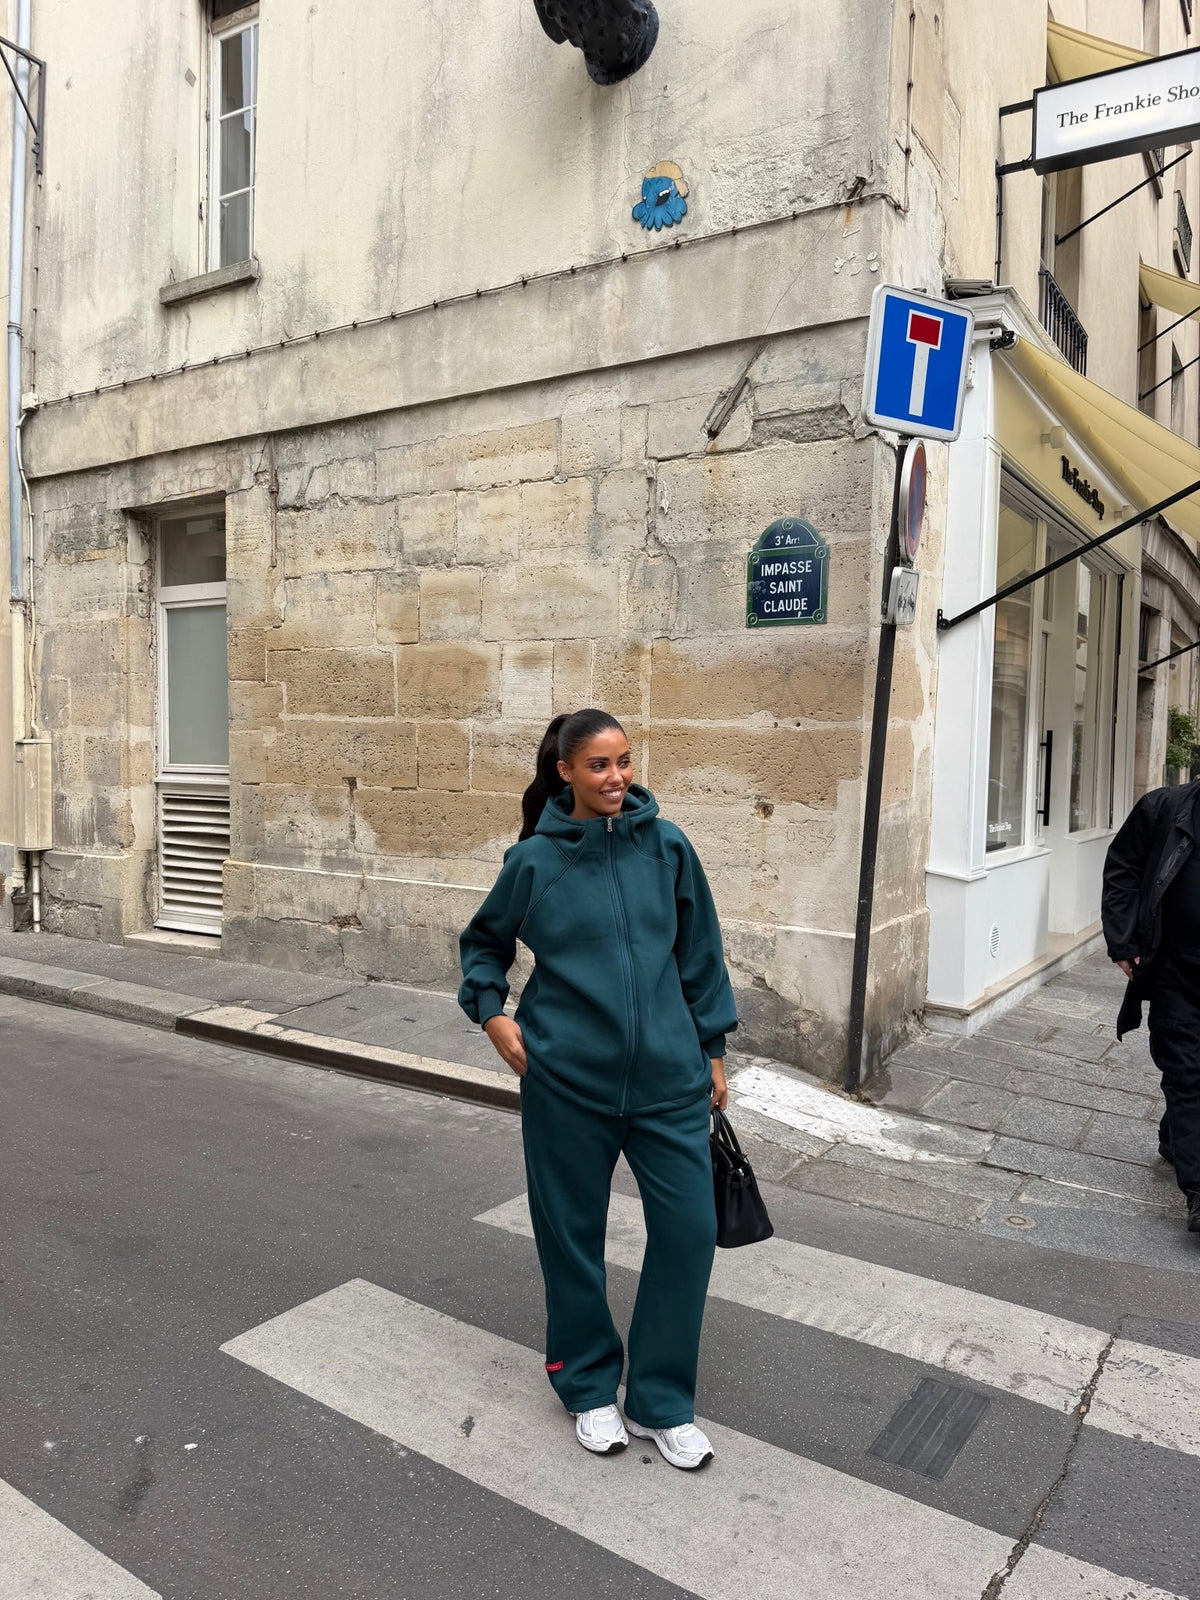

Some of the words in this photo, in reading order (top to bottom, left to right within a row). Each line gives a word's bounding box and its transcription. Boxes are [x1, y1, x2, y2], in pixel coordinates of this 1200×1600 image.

[1056, 111, 1089, 129] The
[1094, 93, 1162, 120] Frankie
[1167, 84, 1200, 103] Sho
[760, 560, 813, 577] IMPASSE
[769, 579, 803, 595] SAINT
[763, 597, 808, 613] CLAUDE
